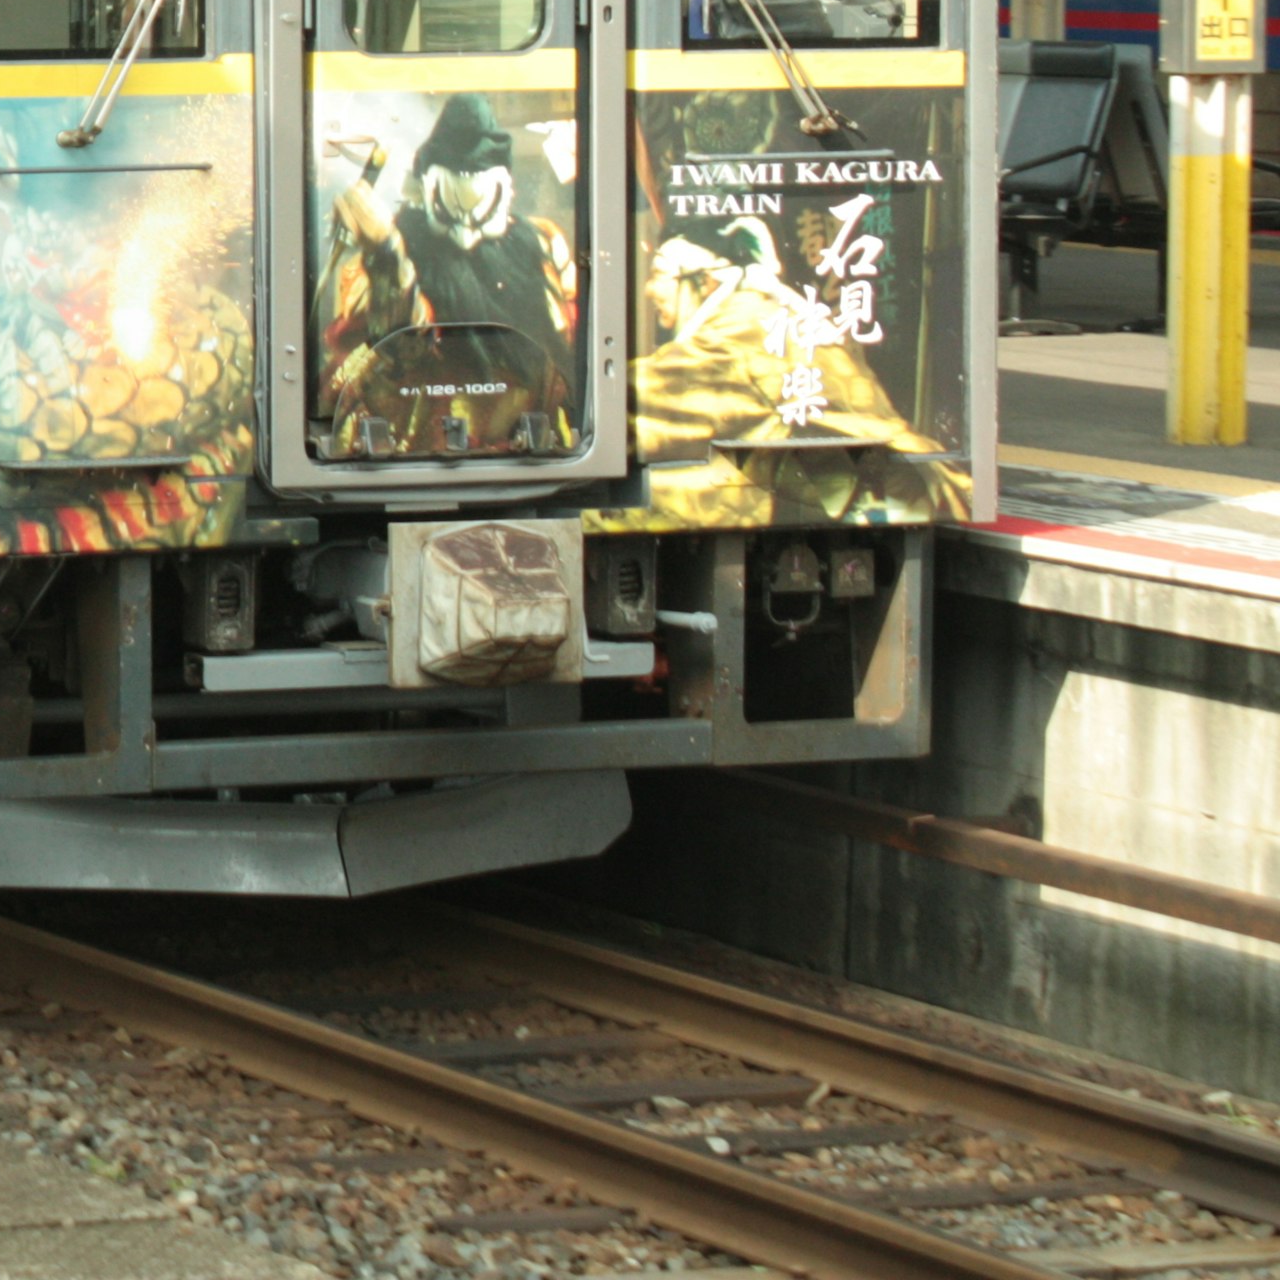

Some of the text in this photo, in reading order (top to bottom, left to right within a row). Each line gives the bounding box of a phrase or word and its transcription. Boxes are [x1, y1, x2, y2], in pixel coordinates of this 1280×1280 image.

[1201, 16, 1249, 38] 出口
[669, 160, 943, 186] IWAMI KAGURA
[668, 193, 782, 216] TRAIN
